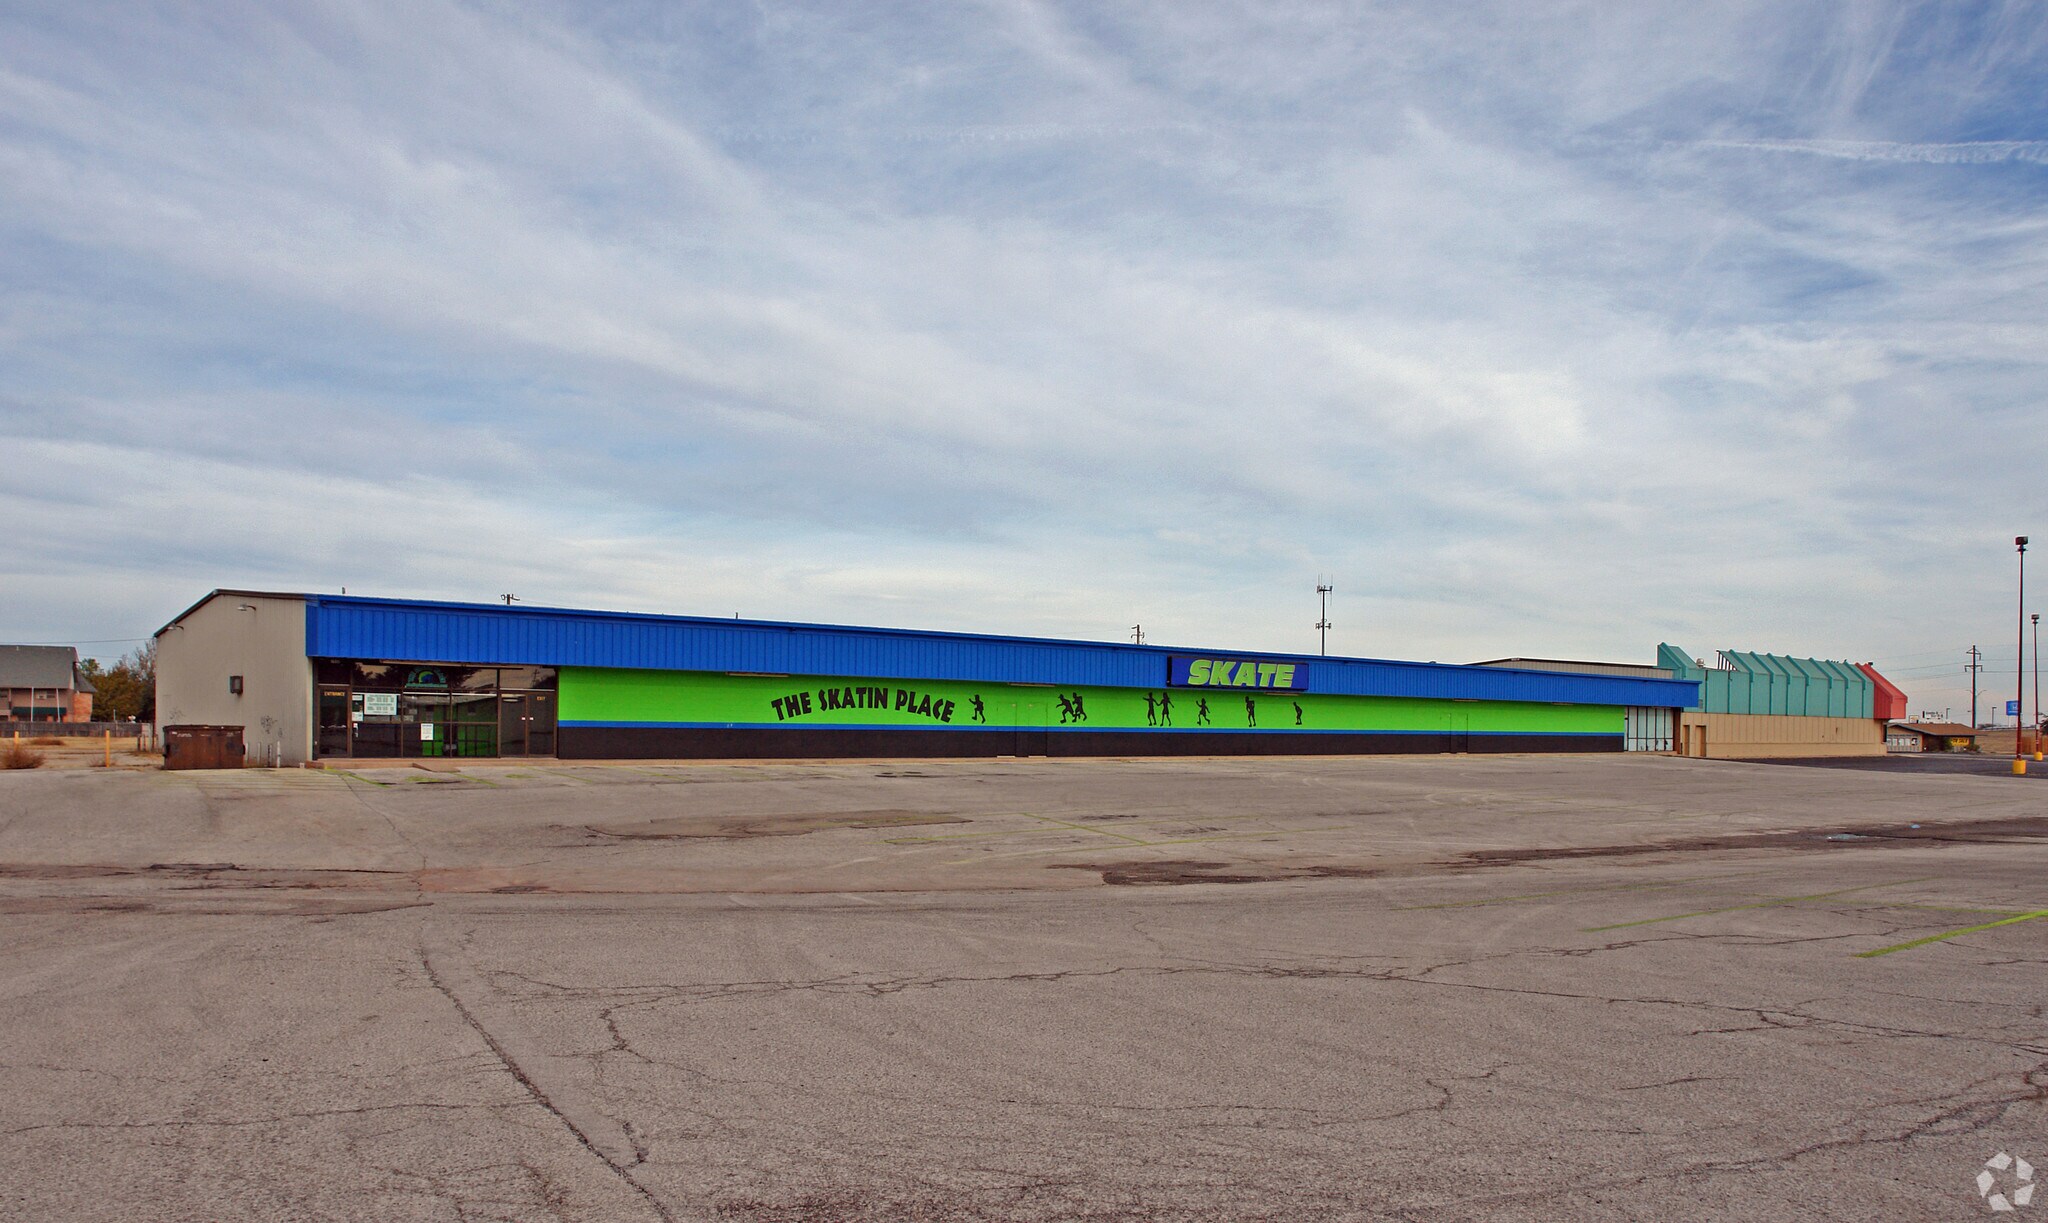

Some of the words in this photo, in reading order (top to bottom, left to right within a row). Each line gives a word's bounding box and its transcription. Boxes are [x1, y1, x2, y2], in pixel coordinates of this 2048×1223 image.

[1187, 659, 1295, 688] SKATE
[771, 692, 812, 721] THE
[818, 687, 888, 712] SKATIN
[894, 689, 955, 723] PLACE
